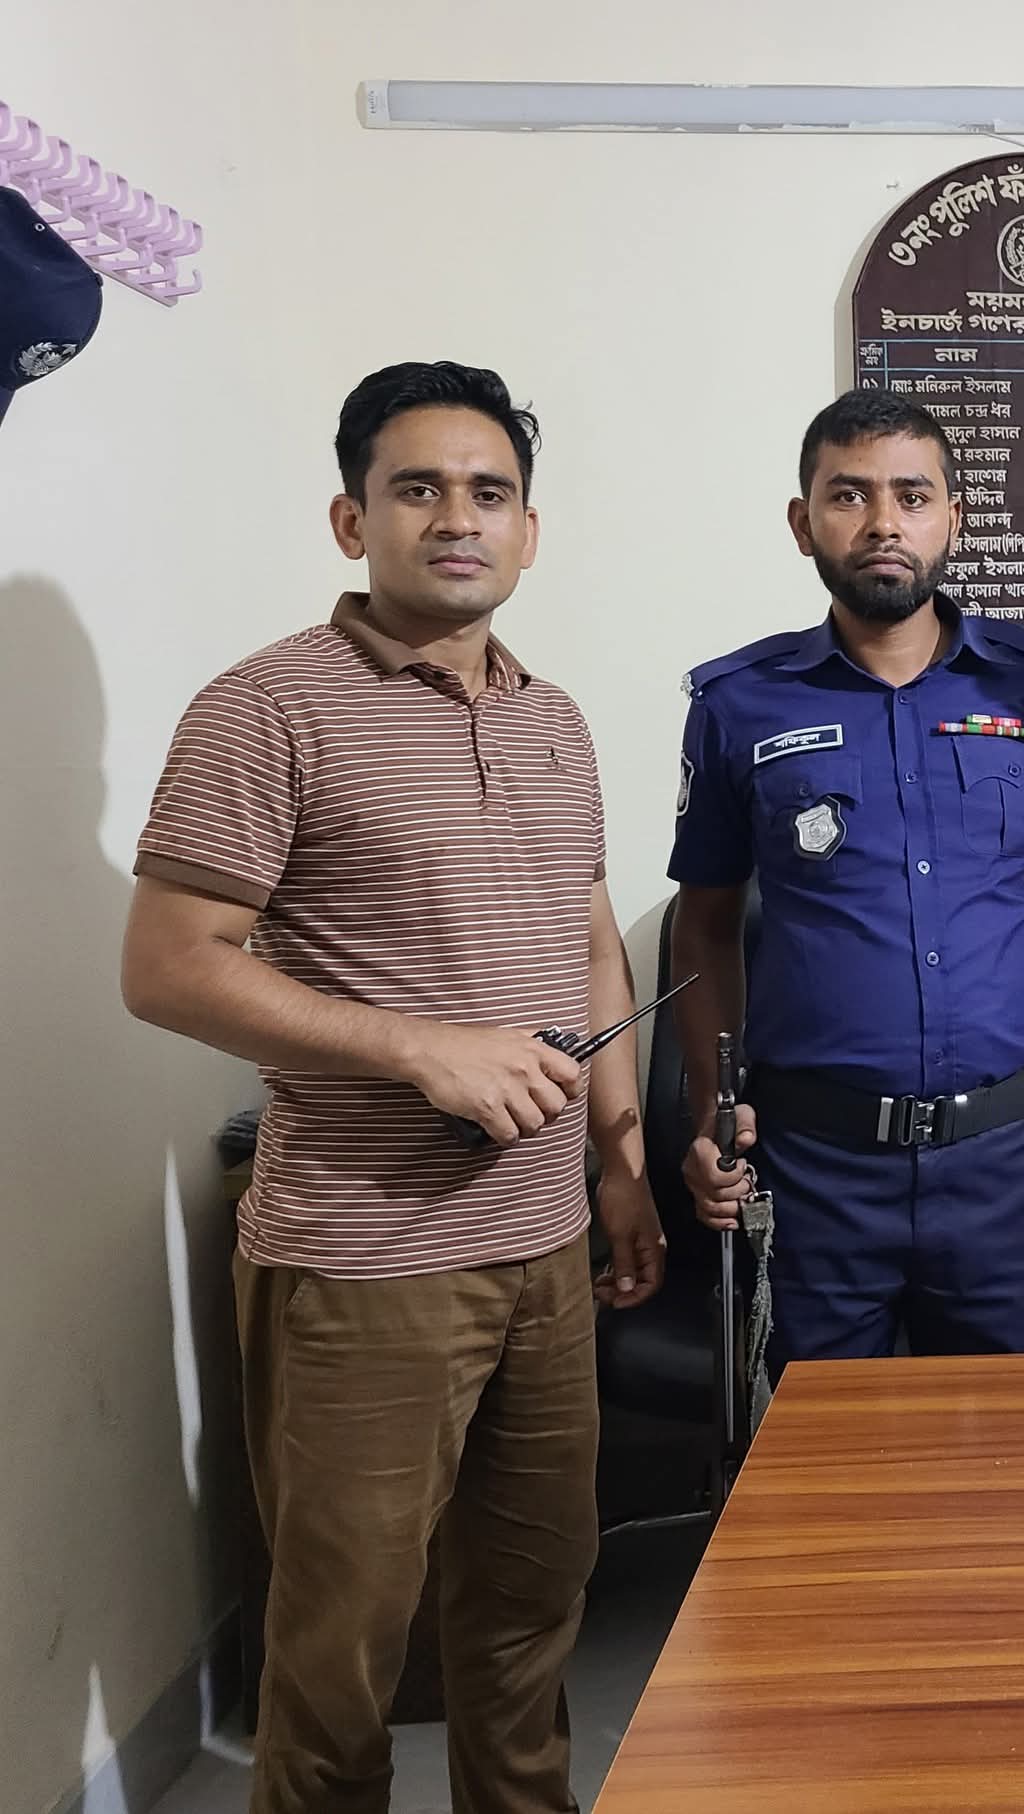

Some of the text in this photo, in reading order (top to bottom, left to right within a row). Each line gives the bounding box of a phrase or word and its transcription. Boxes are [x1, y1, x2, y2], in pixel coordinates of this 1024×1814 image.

[929, 175, 998, 237] পুলিশ
[881, 307, 963, 334] ইনচার্জ
[865, 356, 879, 366] নং
[935, 347, 978, 363] নাম
[915, 375, 963, 394] মনিরুল
[964, 375, 1012, 394] ইসলাম
[963, 404, 989, 418] চন্দ্র
[990, 401, 1012, 418] ধর
[979, 426, 1021, 441] হাসান
[964, 448, 1012, 462] রহমান
[964, 469, 1008, 484] হাশেম
[965, 486, 1005, 506] উদ্দিন
[966, 513, 1013, 529] আকন্দ
[963, 532, 1002, 553] ইসলাম
[965, 582, 1002, 599] হাসান
